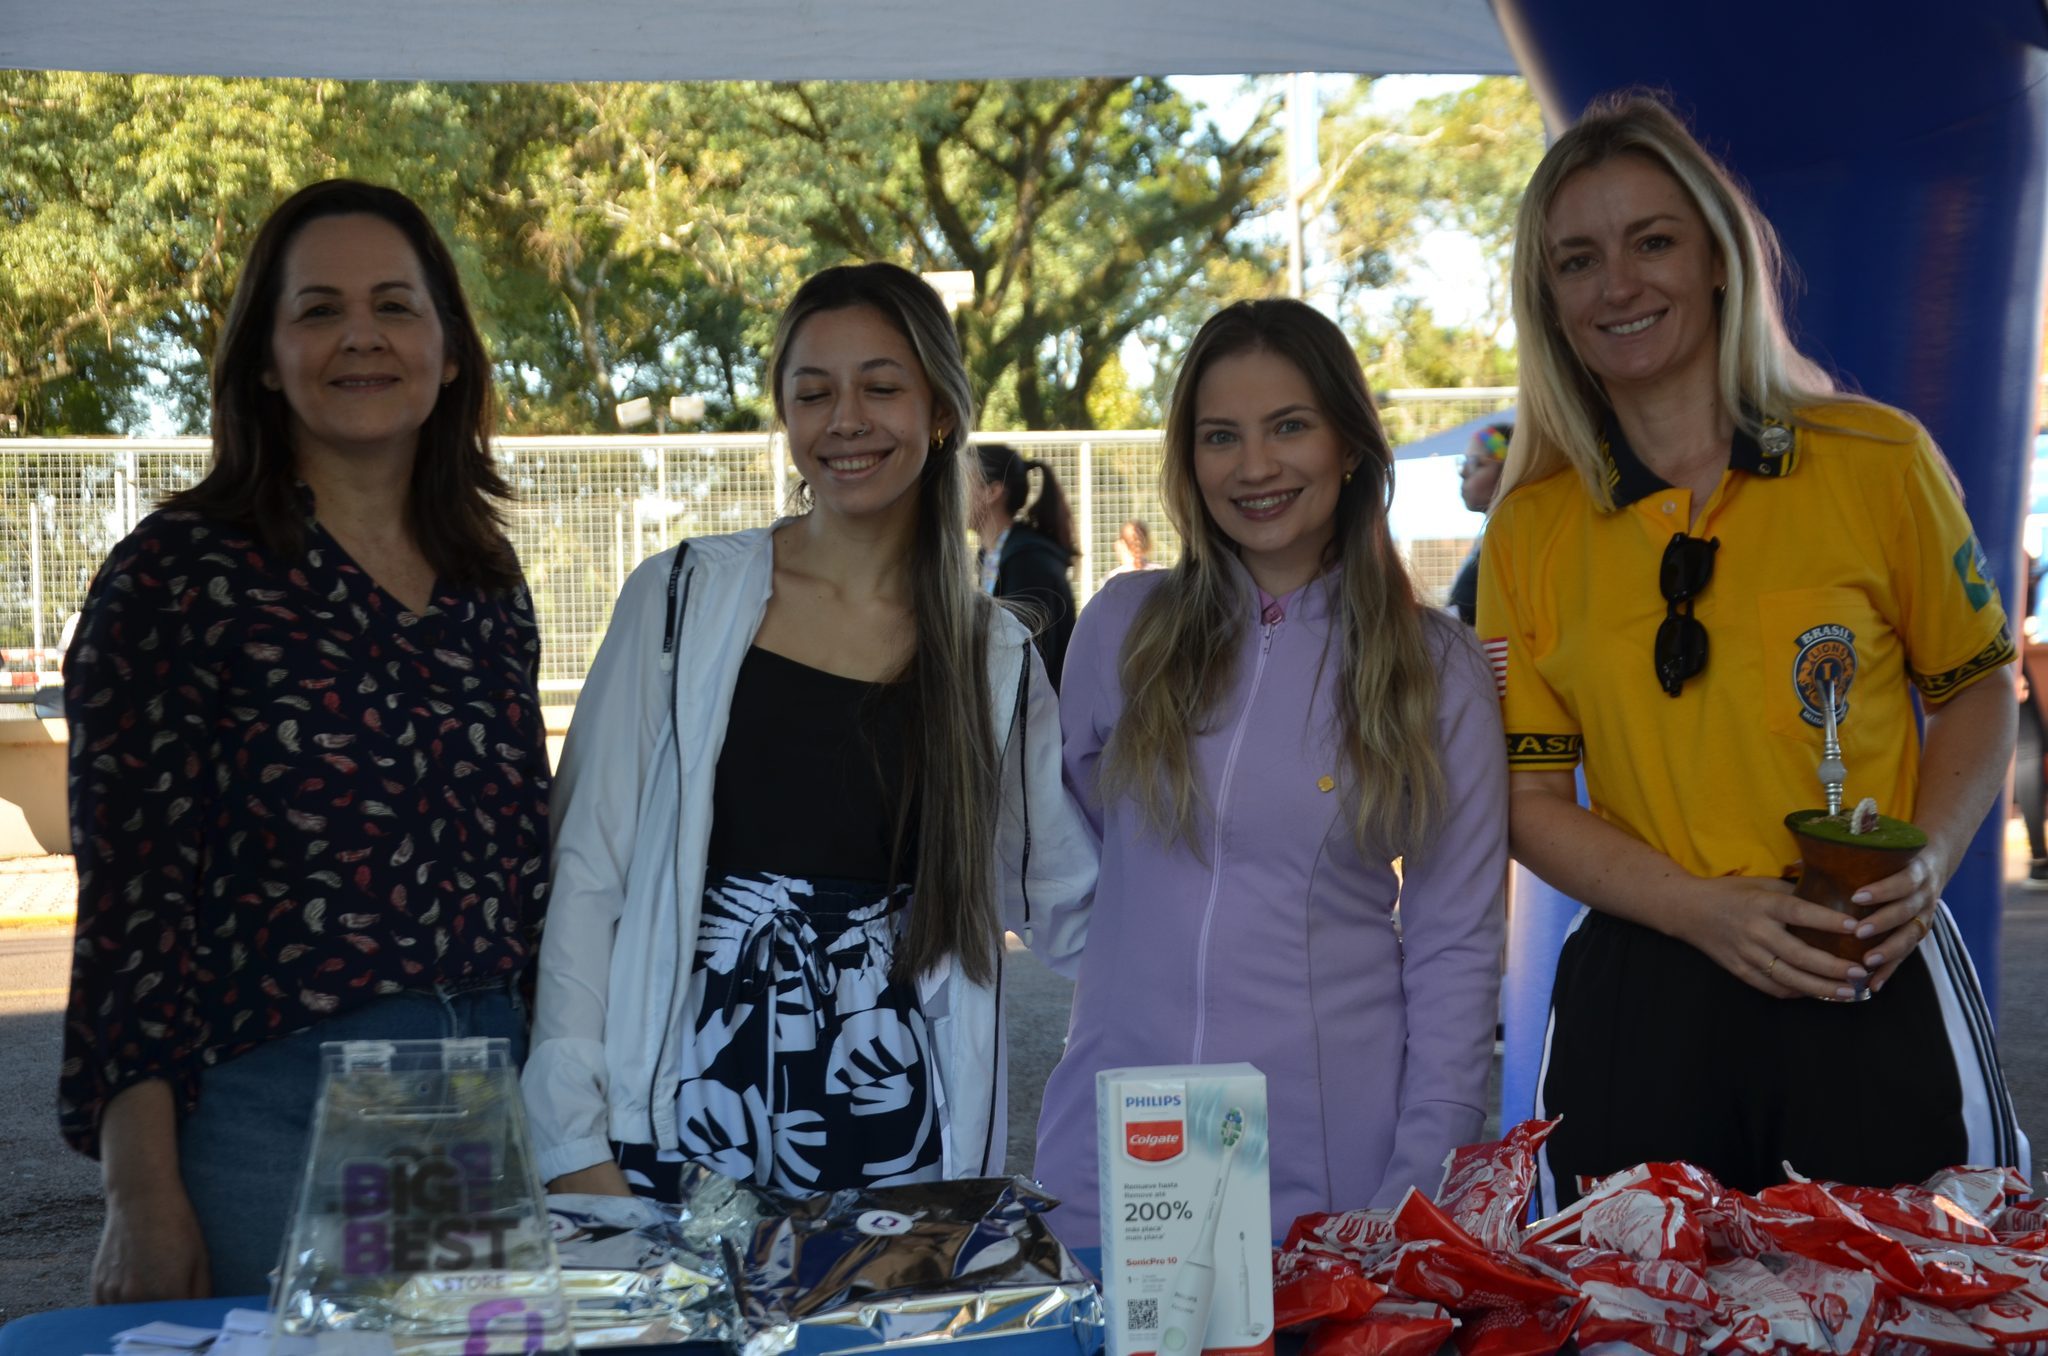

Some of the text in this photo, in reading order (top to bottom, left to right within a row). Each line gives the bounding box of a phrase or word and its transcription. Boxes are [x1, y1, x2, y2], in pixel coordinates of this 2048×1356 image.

[1801, 625, 1850, 645] BRASIL
[1811, 643, 1848, 661] LIONS
[1125, 1095, 1182, 1107] PHILIPS
[1130, 1134, 1179, 1146] Colgate
[344, 1158, 464, 1216] BIG
[1158, 1181, 1179, 1189] hasta
[1124, 1200, 1193, 1222] 200%
[344, 1216, 520, 1275] BEST
[1126, 1256, 1178, 1267] SonicPro 10
[442, 1275, 507, 1291] STORE
